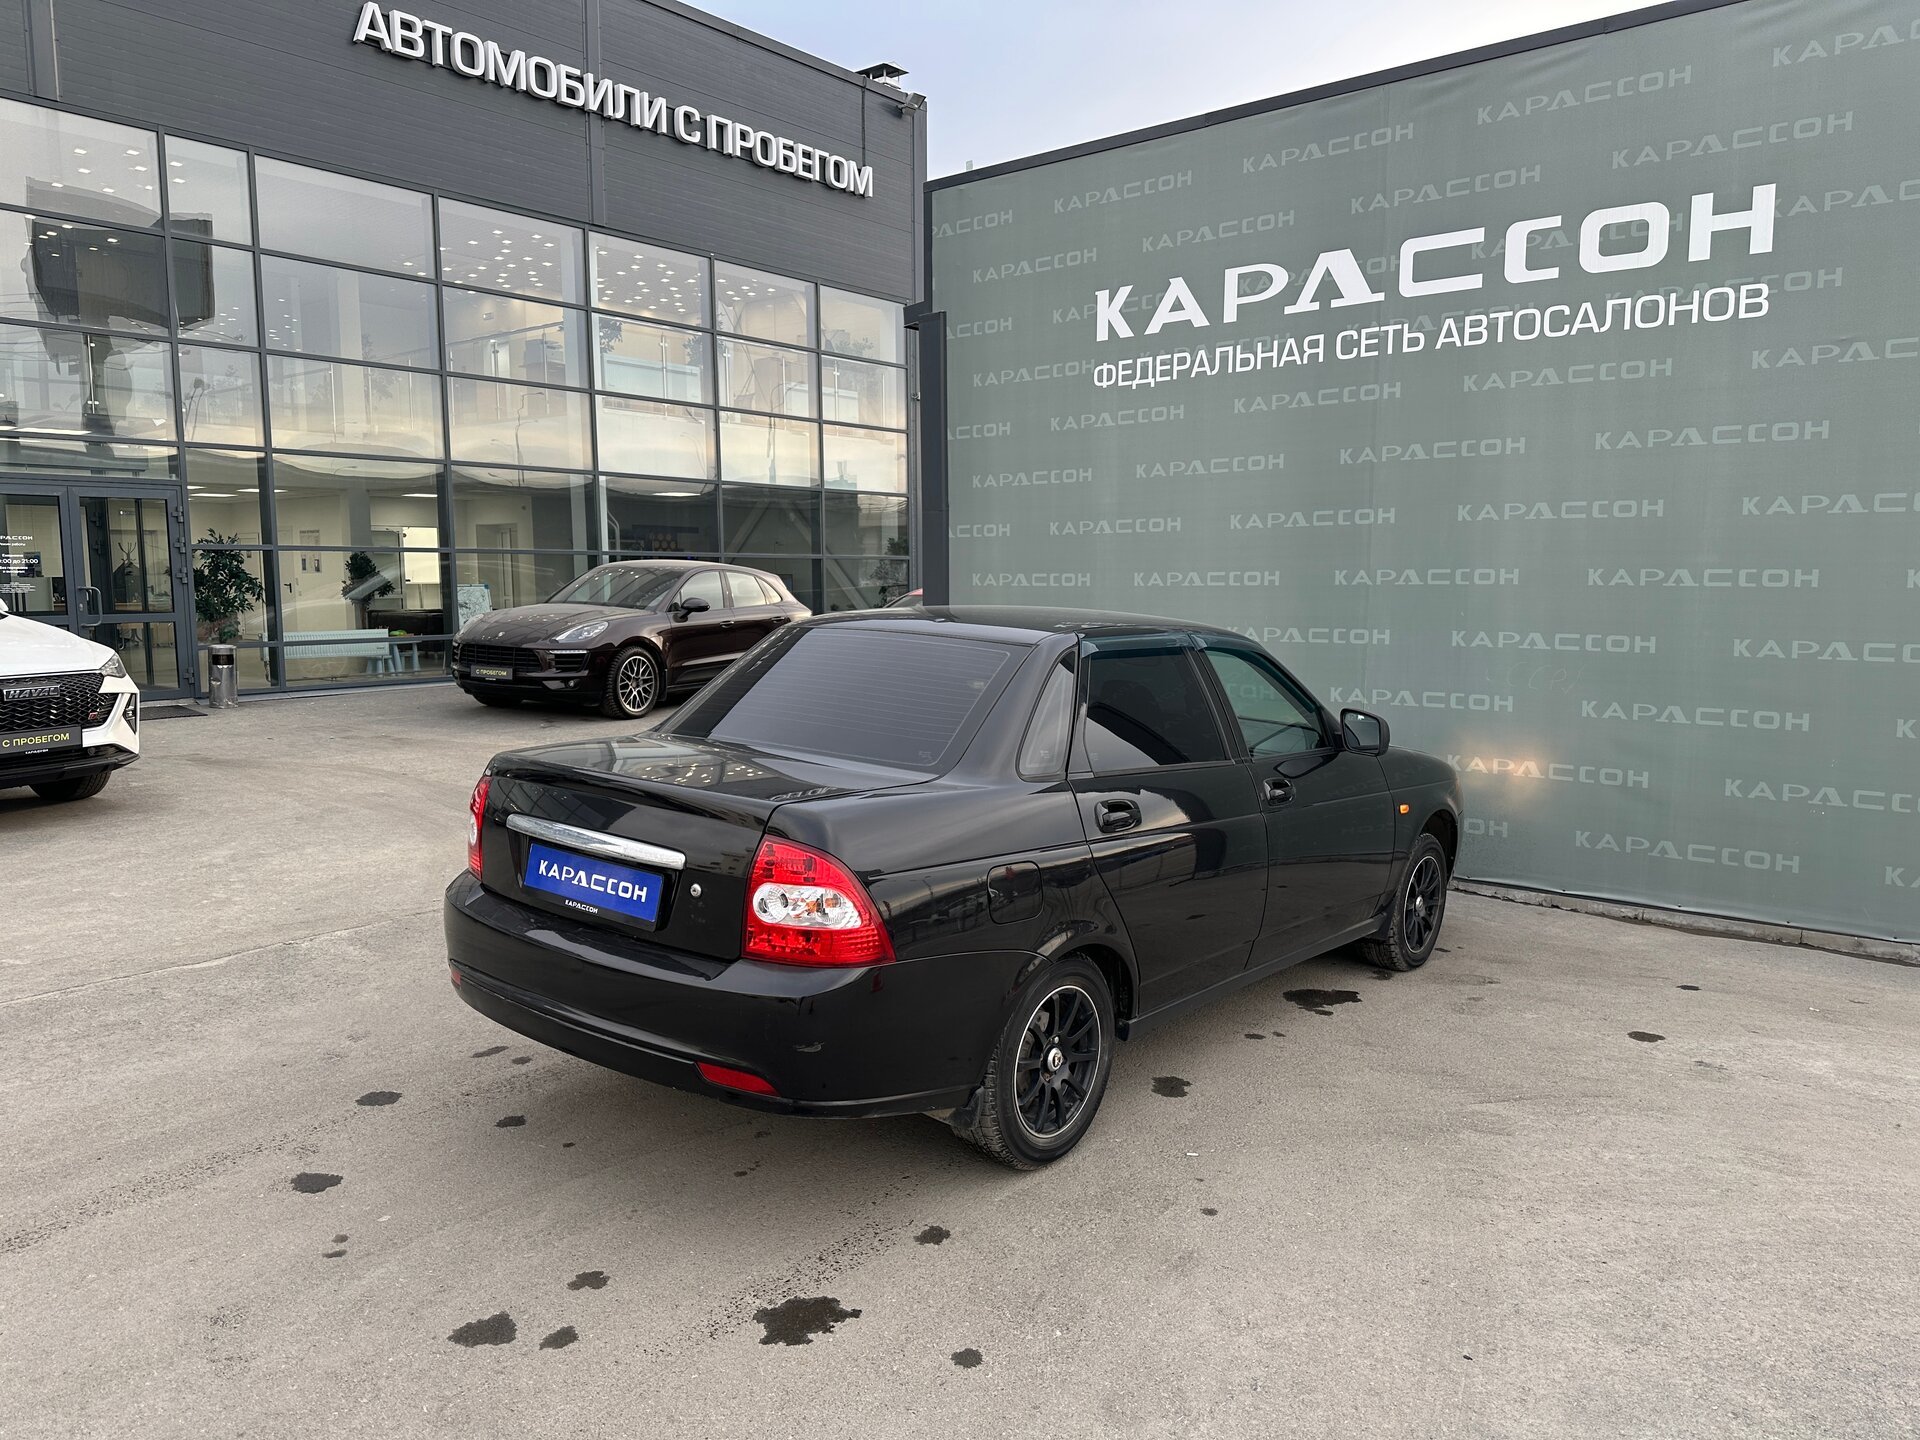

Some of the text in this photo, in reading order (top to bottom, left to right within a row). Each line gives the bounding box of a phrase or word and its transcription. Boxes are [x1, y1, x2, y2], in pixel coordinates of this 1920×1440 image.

[353, 1, 873, 198] АВТОМОБИЛИ С ПРОБЕГОМ
[1477, 65, 1692, 125] КАРАССОН
[1242, 122, 1413, 174] КАРАССОН
[1612, 111, 1854, 169] КАРАССОН
[1054, 170, 1192, 214] КАРАССОН
[1350, 164, 1541, 215] КАРАССОН
[1142, 209, 1295, 253] КАРАССОН
[973, 247, 1097, 284] КАРАССОН
[1095, 183, 1776, 342] КАРАССОН
[1093, 283, 1770, 390] ФЕДЕРАЛЬНАЯ СЕТЬ АВТОСАЛОНОВ
[1751, 337, 1920, 369] КАРАС
[973, 359, 1096, 387] КАРАССОН
[1463, 358, 1673, 392] КАРАССОН
[1234, 381, 1401, 414] КАРАССОН
[1050, 404, 1185, 432] КАРАССОН
[1595, 420, 1830, 450] КАРАССОН
[1136, 453, 1285, 479] КАРАССОН
[1339, 437, 1526, 465] КАРАССОН
[972, 467, 1093, 488] КАРАССОН
[1230, 507, 1396, 530] КАРАССОН
[1457, 499, 1664, 521] КАРАССОН
[1742, 492, 1920, 516] КАРАС
[1049, 516, 1181, 536] КАРАССОН
[972, 572, 1091, 587] КАРАССОН
[1134, 571, 1280, 587] КАРАССОН
[1334, 568, 1520, 587] КАРАССОН
[1587, 567, 1820, 588] КАРАССОН
[1451, 630, 1657, 654] КАРАССОН
[8, 687, 58, 699] HAVAL
[1330, 686, 1514, 712] КАРАССОН
[1581, 700, 1811, 732] КАРАССОН
[2, 733, 70, 748] С ПРОБЕГОМ
[1446, 753, 1649, 789] КАРАССОН
[1725, 778, 1920, 814] КАРАСС
[1575, 830, 1800, 874] КАРАССОН
[538, 860, 648, 902] КАРАССОН
[564, 899, 599, 914] КАРАССОН
